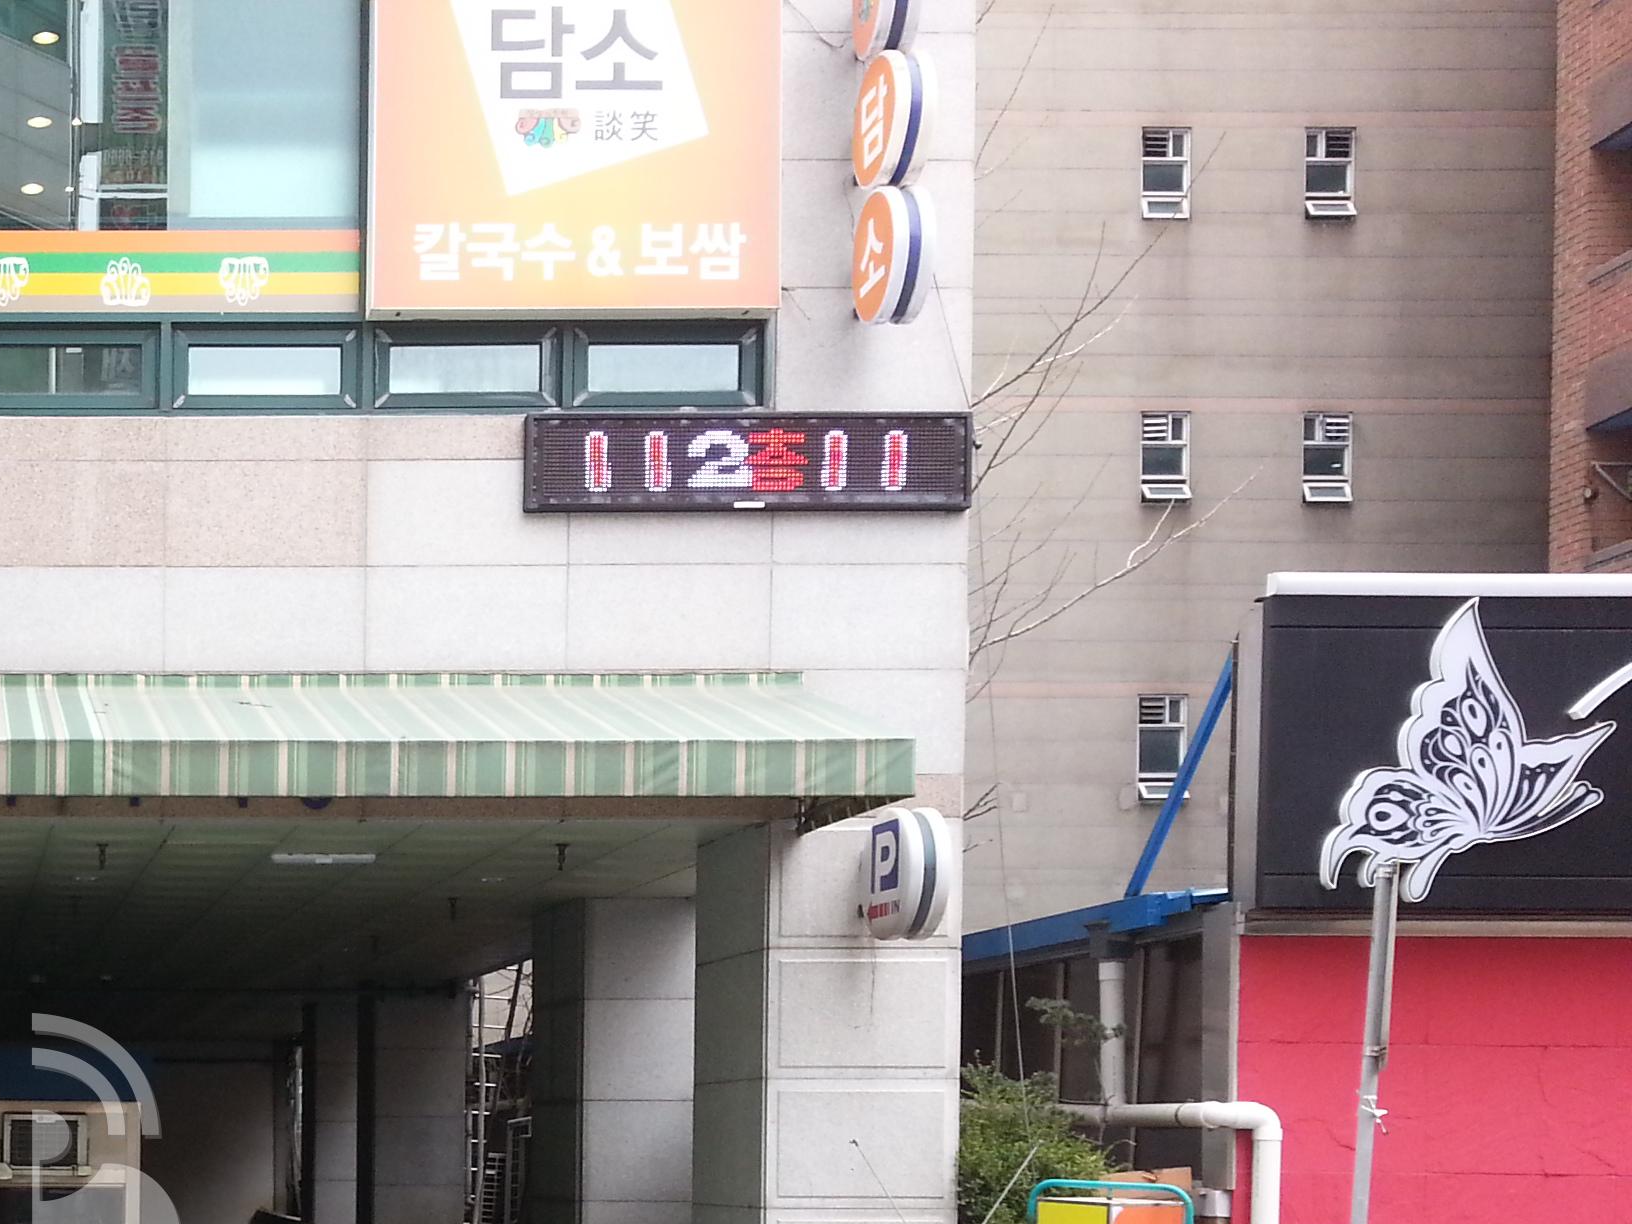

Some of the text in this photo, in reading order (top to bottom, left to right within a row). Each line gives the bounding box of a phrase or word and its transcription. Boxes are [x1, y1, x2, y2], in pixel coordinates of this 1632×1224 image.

[489, 5, 664, 99] 담소
[593, 110, 659, 142] 談笑
[413, 221, 748, 282] 칼국수 & 보쌈
[875, 830, 897, 893] P
